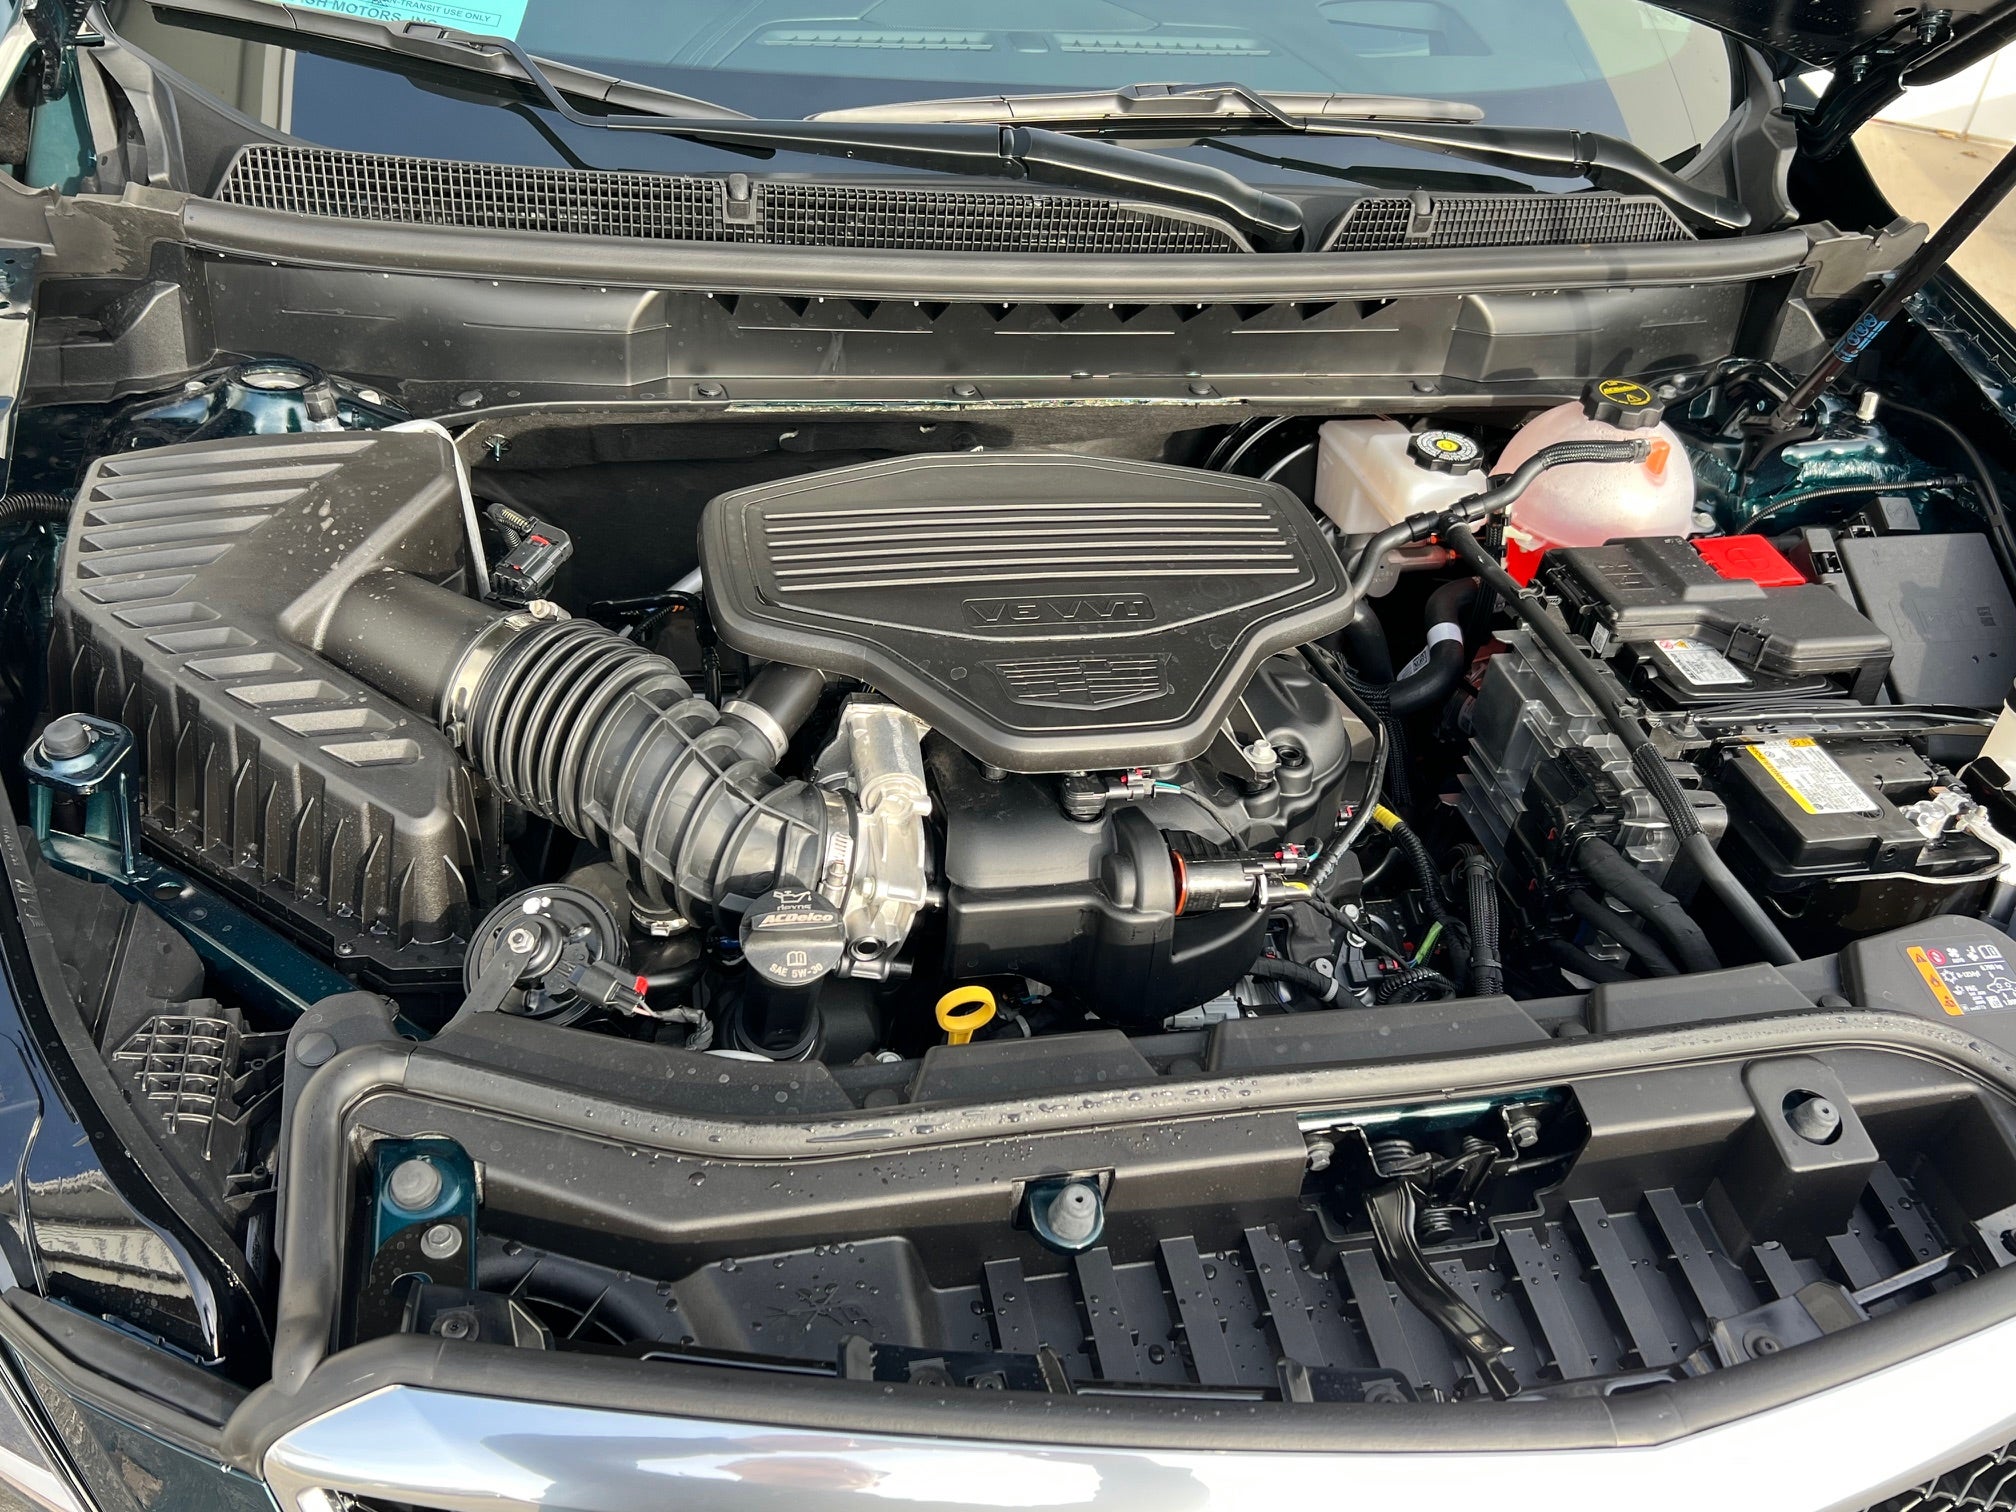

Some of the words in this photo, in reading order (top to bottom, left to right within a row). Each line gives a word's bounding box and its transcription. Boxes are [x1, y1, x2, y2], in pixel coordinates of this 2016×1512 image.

[331, 1, 402, 21] MOTORS
[443, 8, 464, 17] USE
[465, 12, 491, 22] ONLY
[970, 603, 1041, 622] V6
[1047, 600, 1144, 619] VVT
[761, 912, 834, 924] ACDelco
[769, 963, 789, 977] SAE
[791, 962, 824, 978] 5W-30
